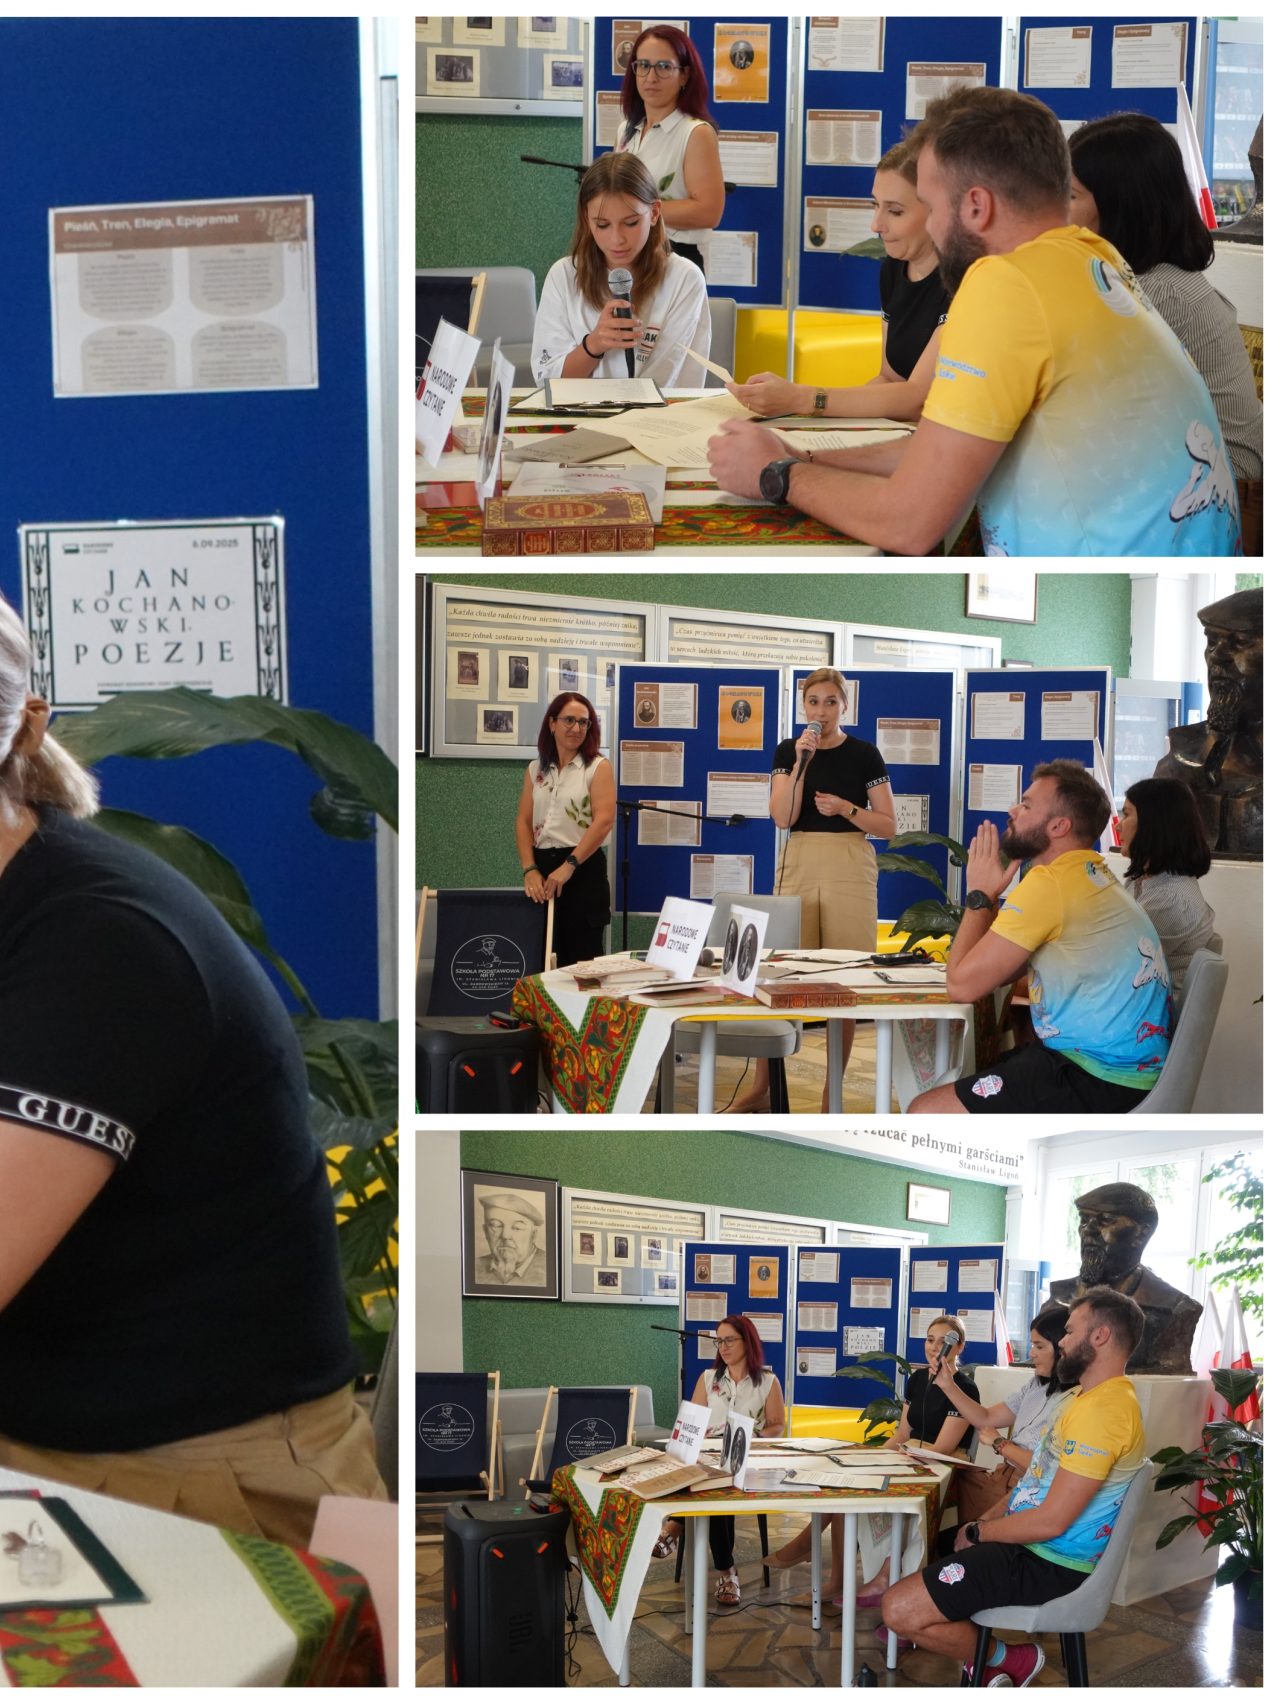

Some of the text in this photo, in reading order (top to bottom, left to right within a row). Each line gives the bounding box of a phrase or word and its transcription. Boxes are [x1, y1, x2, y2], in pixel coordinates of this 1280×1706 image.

[102, 218, 132, 232] Tren,
[134, 215, 174, 230] Elegia,
[176, 213, 240, 229] Epigramat
[104, 567, 189, 596] JAN
[74, 640, 235, 666] POEZJE
[671, 924, 699, 940] NARODOWE
[911, 1133, 963, 1155] pełnymi
[958, 1159, 1019, 1180] Stanisław Ligoń
